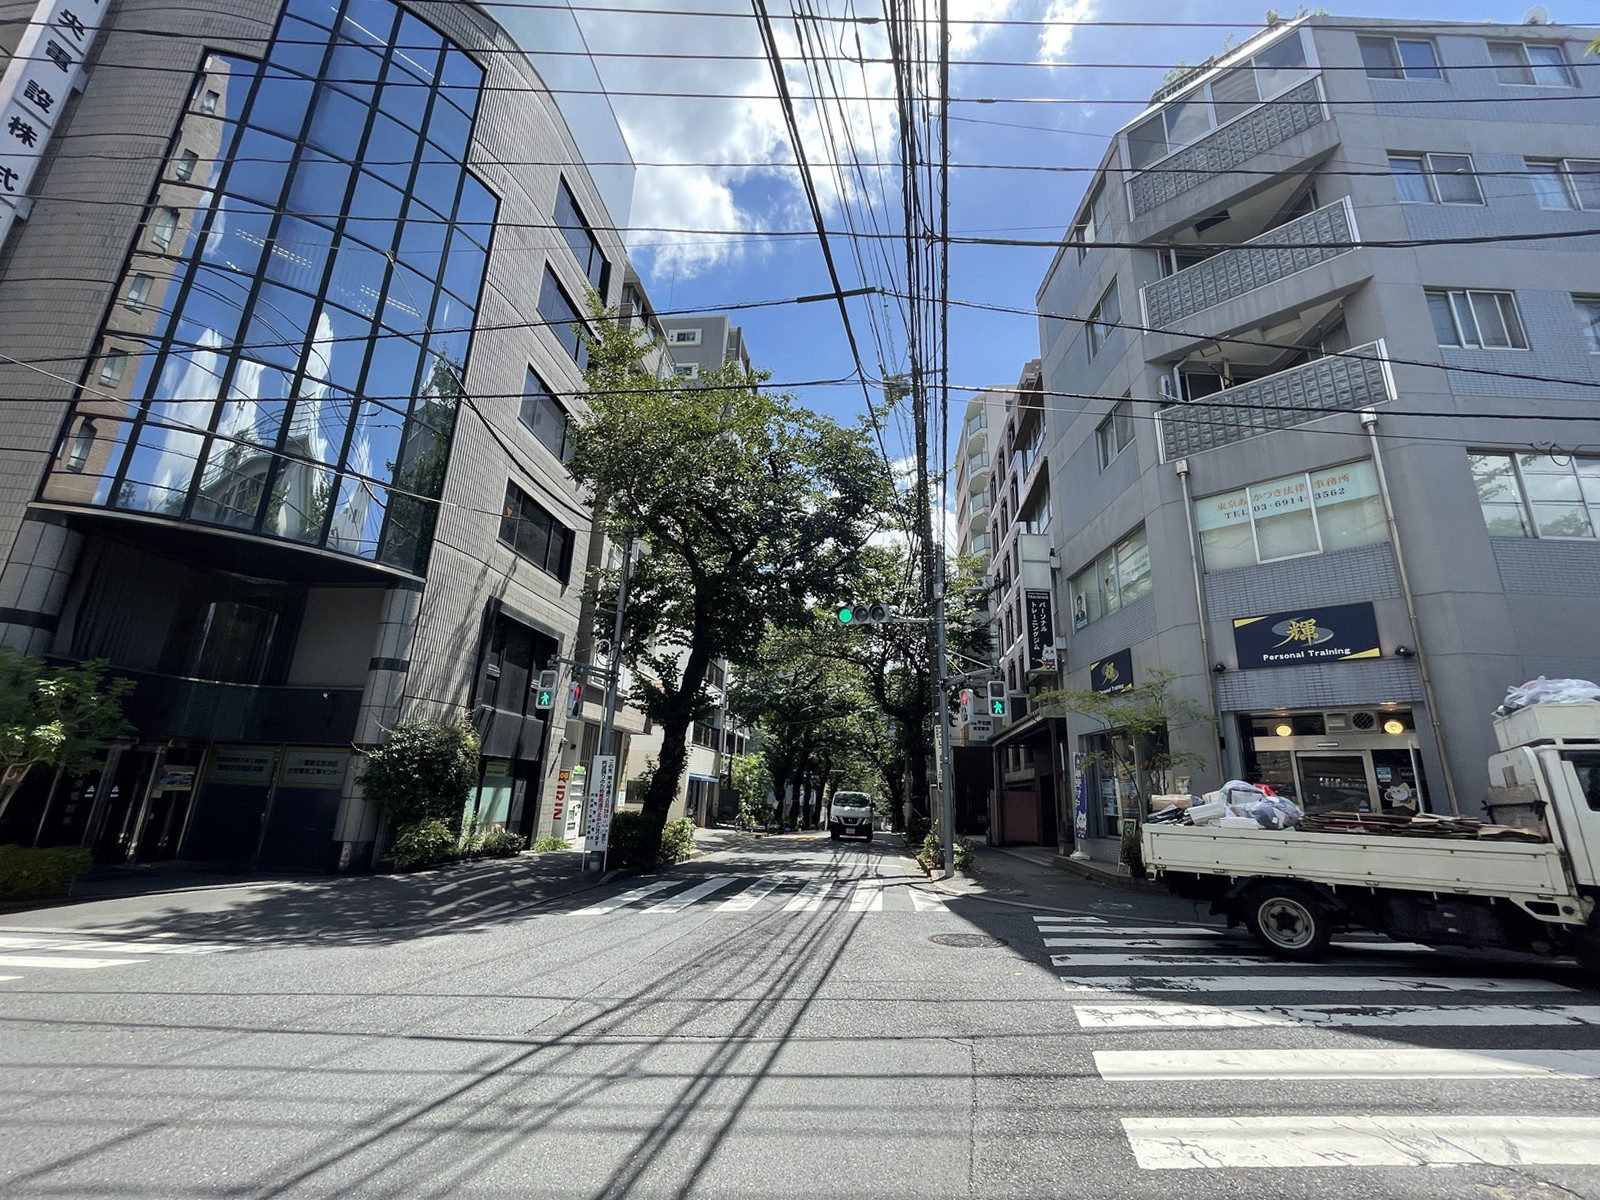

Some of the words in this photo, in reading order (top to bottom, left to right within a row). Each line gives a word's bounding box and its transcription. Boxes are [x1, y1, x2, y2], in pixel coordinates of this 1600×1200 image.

[0, 0, 100, 219] 央電設株式
[1217, 473, 1350, 511] 東京あかつき法律事務所
[1224, 510, 1249, 519] TEL
[1253, 487, 1346, 513] 03-6914-3562
[1031, 601, 1041, 650] トレーニングジム
[1039, 601, 1048, 632] パーソナル
[1263, 651, 1305, 661] Personal
[1308, 647, 1351, 657] Training
